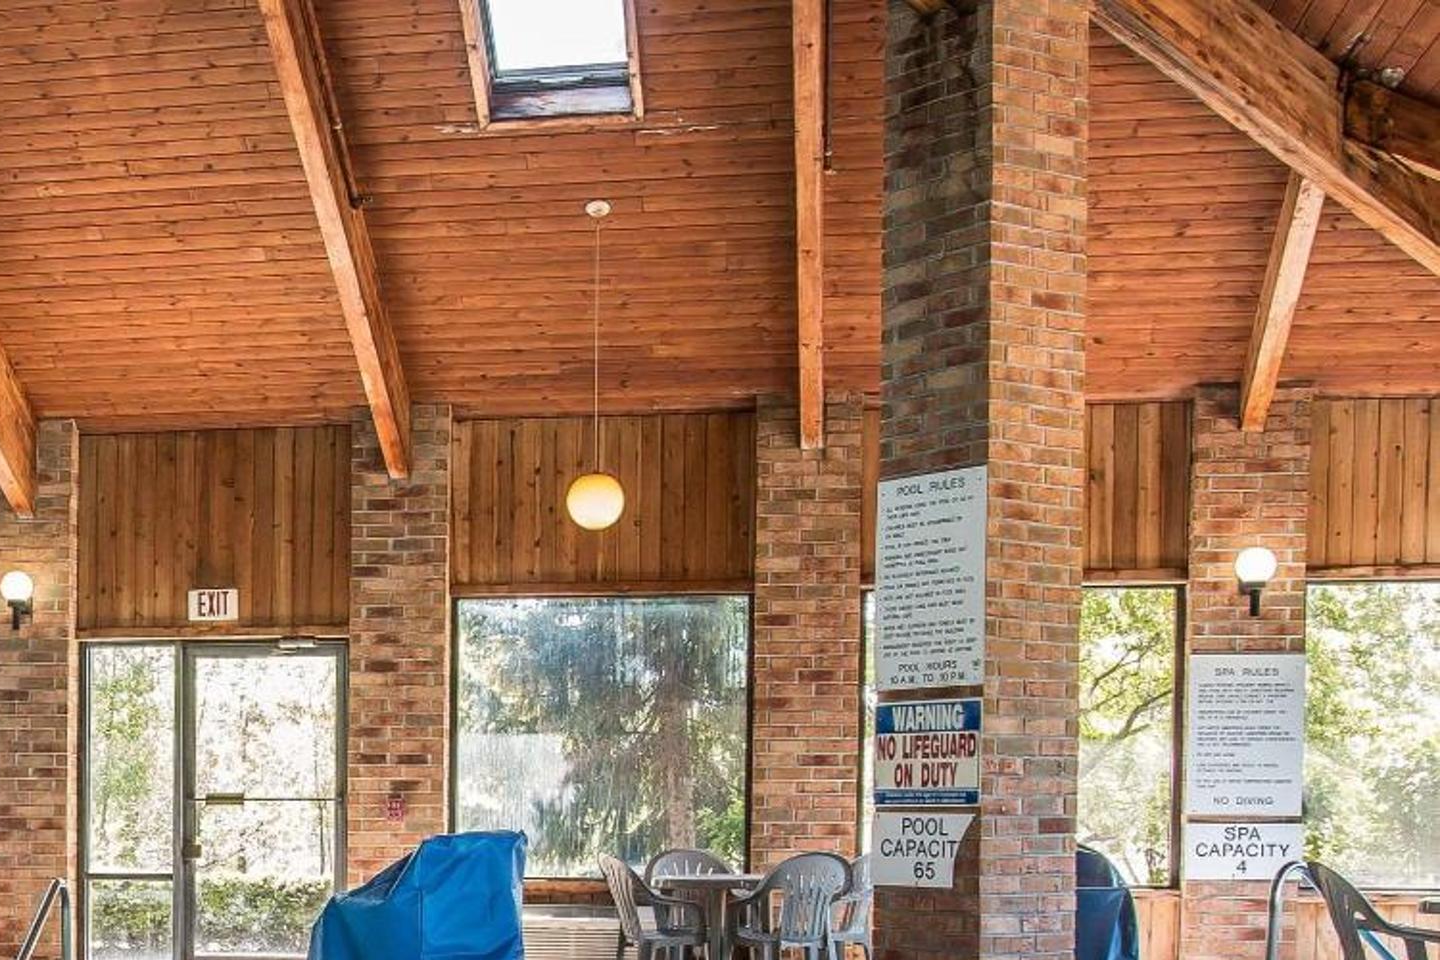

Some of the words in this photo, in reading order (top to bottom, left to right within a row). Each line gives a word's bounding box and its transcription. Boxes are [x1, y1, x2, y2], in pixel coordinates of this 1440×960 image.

[197, 591, 229, 617] EXIT
[892, 703, 965, 732] WARNING
[877, 735, 896, 761] NO
[902, 733, 976, 759] LIFEGUARD
[894, 763, 913, 788] ON
[921, 762, 958, 787] DUTY
[901, 817, 948, 836] POOL
[1224, 827, 1261, 841] SPA
[880, 838, 958, 858] CAPACIT
[1195, 843, 1290, 858] CAPACITY
[913, 861, 935, 880] 65
[1236, 860, 1247, 874] 4
